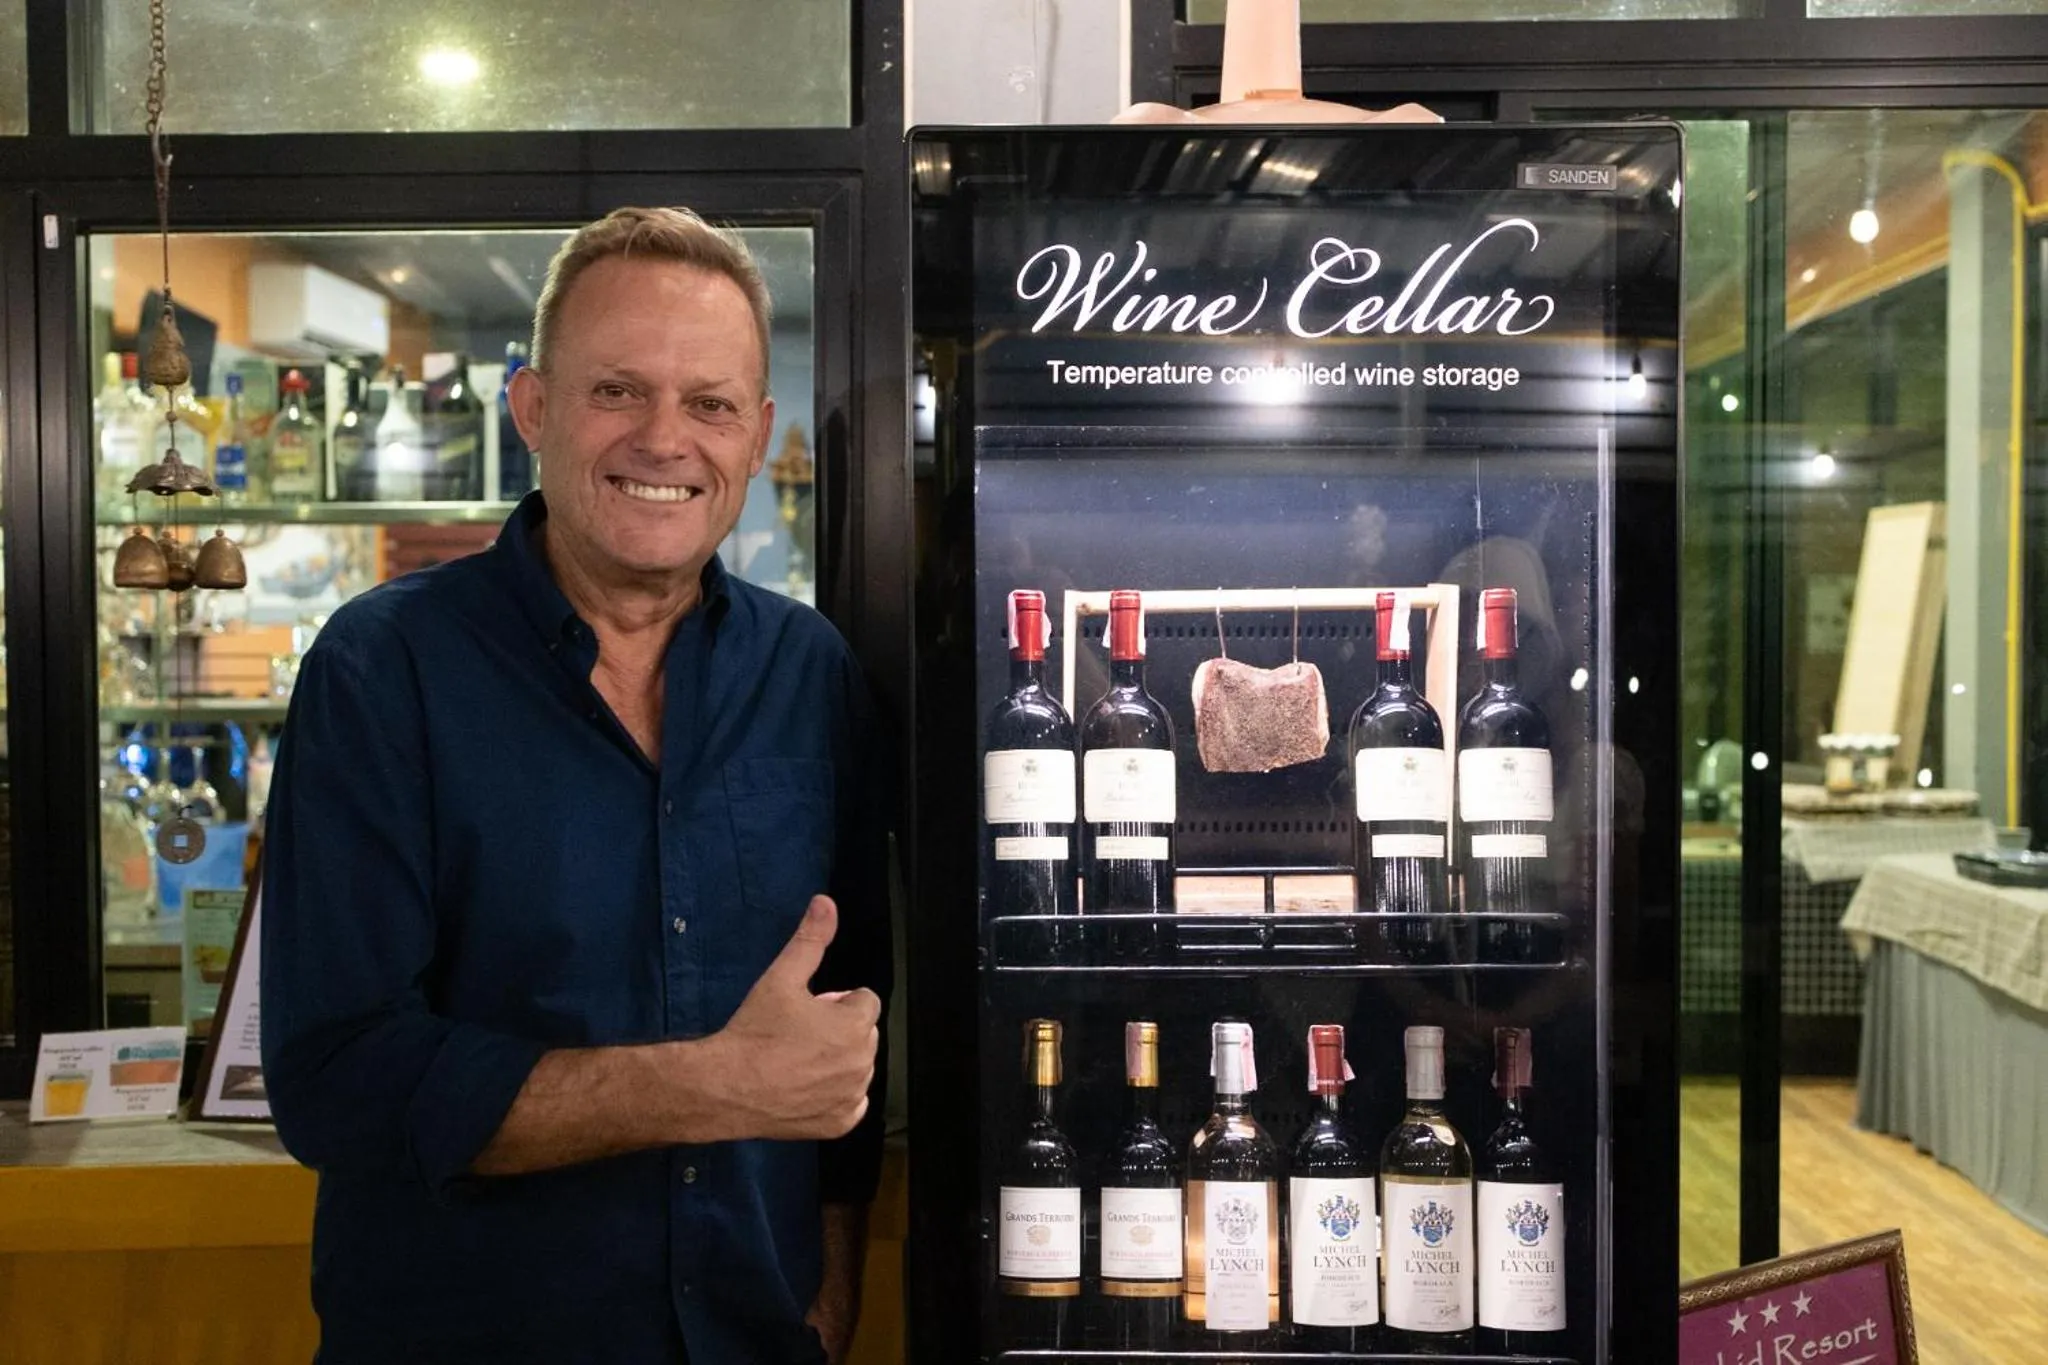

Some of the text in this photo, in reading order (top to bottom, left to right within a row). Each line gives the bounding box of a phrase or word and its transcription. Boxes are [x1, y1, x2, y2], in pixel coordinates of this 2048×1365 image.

[1548, 169, 1610, 184] SANDEN
[1016, 217, 1555, 339] Wine Cellar
[1047, 360, 1213, 389] Temperature
[1354, 363, 1415, 386] wine
[1422, 363, 1520, 391] storage
[1215, 1248, 1257, 1257] MICHEL
[1321, 1245, 1361, 1254] MICHEL
[1411, 1250, 1454, 1260] MICHEL
[1507, 1250, 1549, 1260] MICHEL
[1210, 1258, 1264, 1271] LYNCH
[1313, 1255, 1367, 1268] LYNCH
[1405, 1261, 1460, 1274] LYNCH
[1501, 1259, 1557, 1273] LYNCH
[1773, 1317, 1878, 1365] Resort
